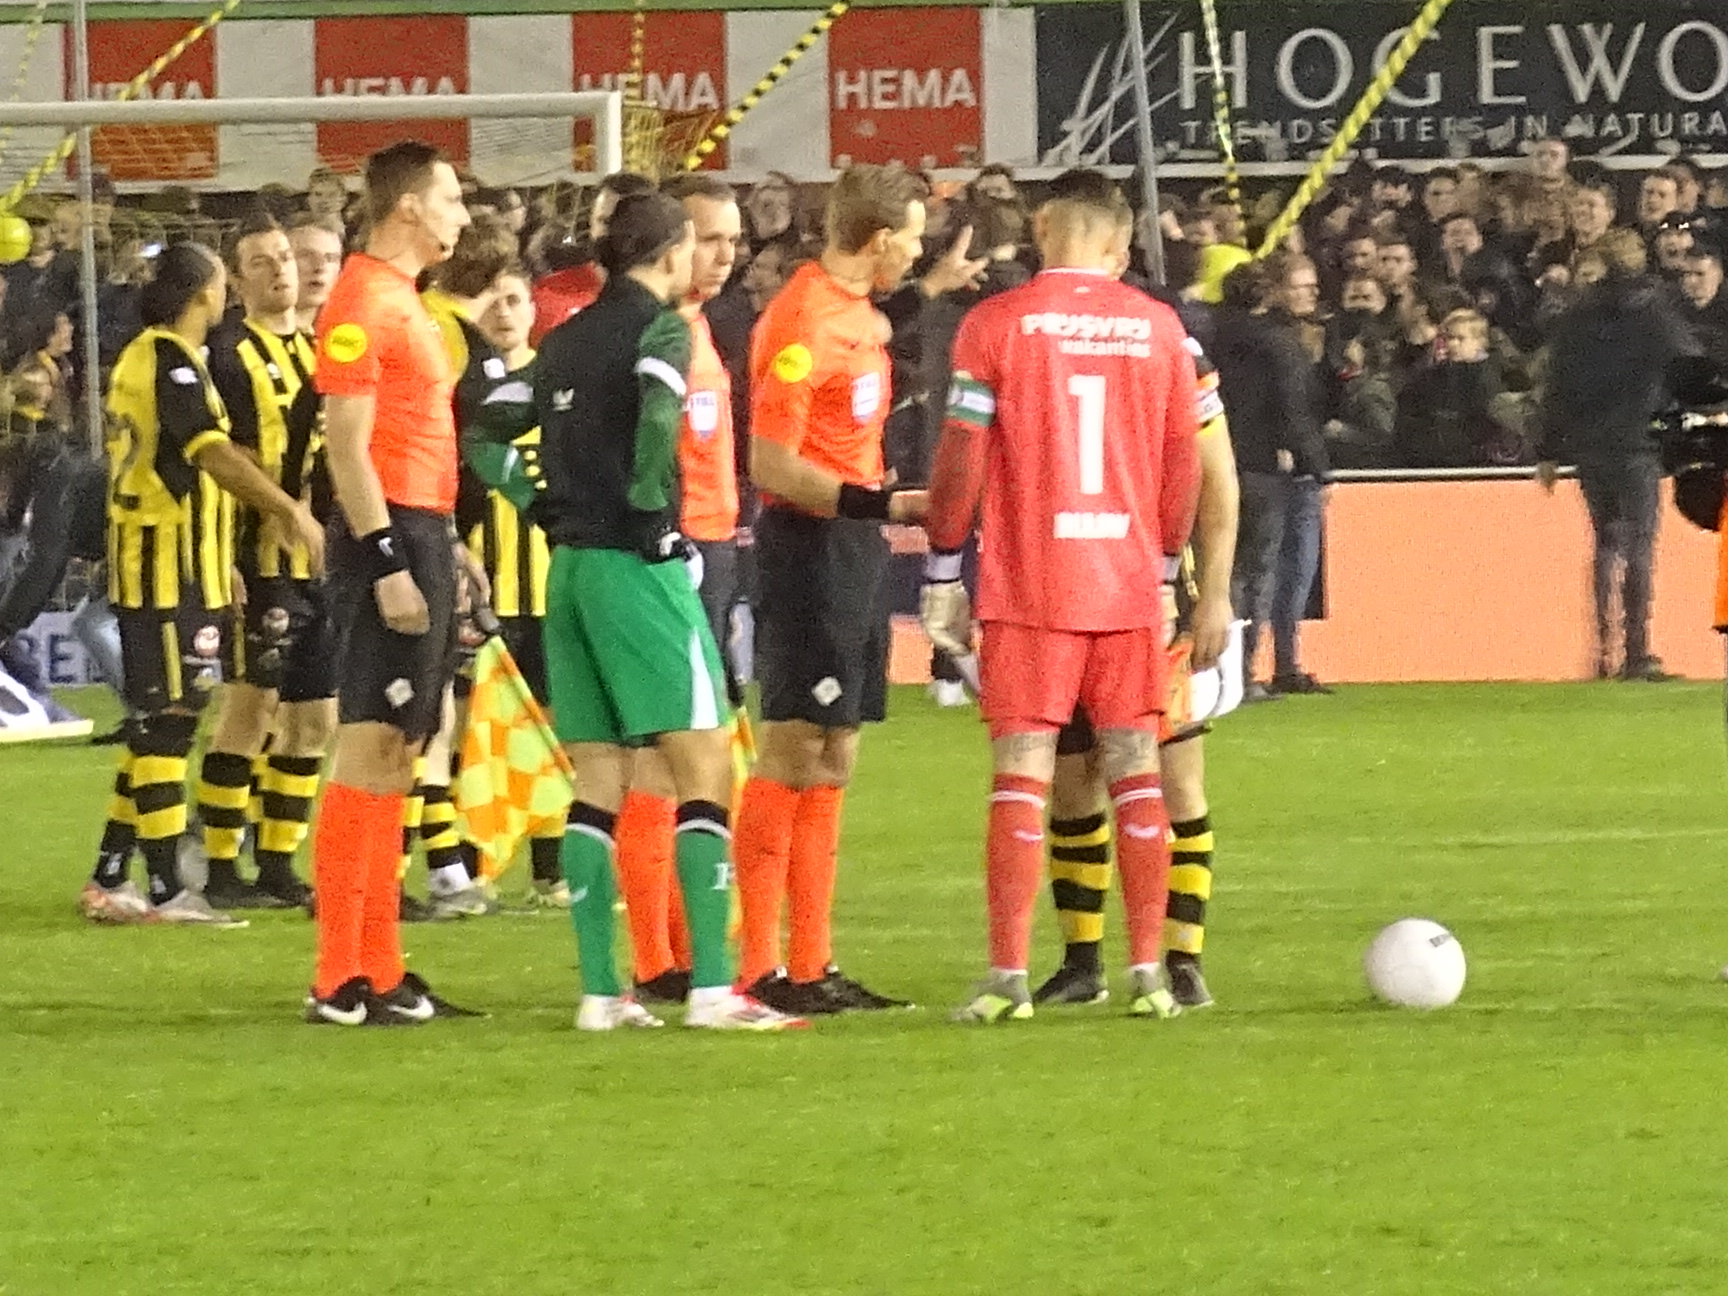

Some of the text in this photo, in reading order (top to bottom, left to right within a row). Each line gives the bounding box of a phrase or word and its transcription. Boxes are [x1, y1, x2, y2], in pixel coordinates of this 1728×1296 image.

[835, 68, 978, 110] HEMA
[1179, 115, 1485, 144] TENDSTTERS
[1069, 374, 1106, 495] 1
